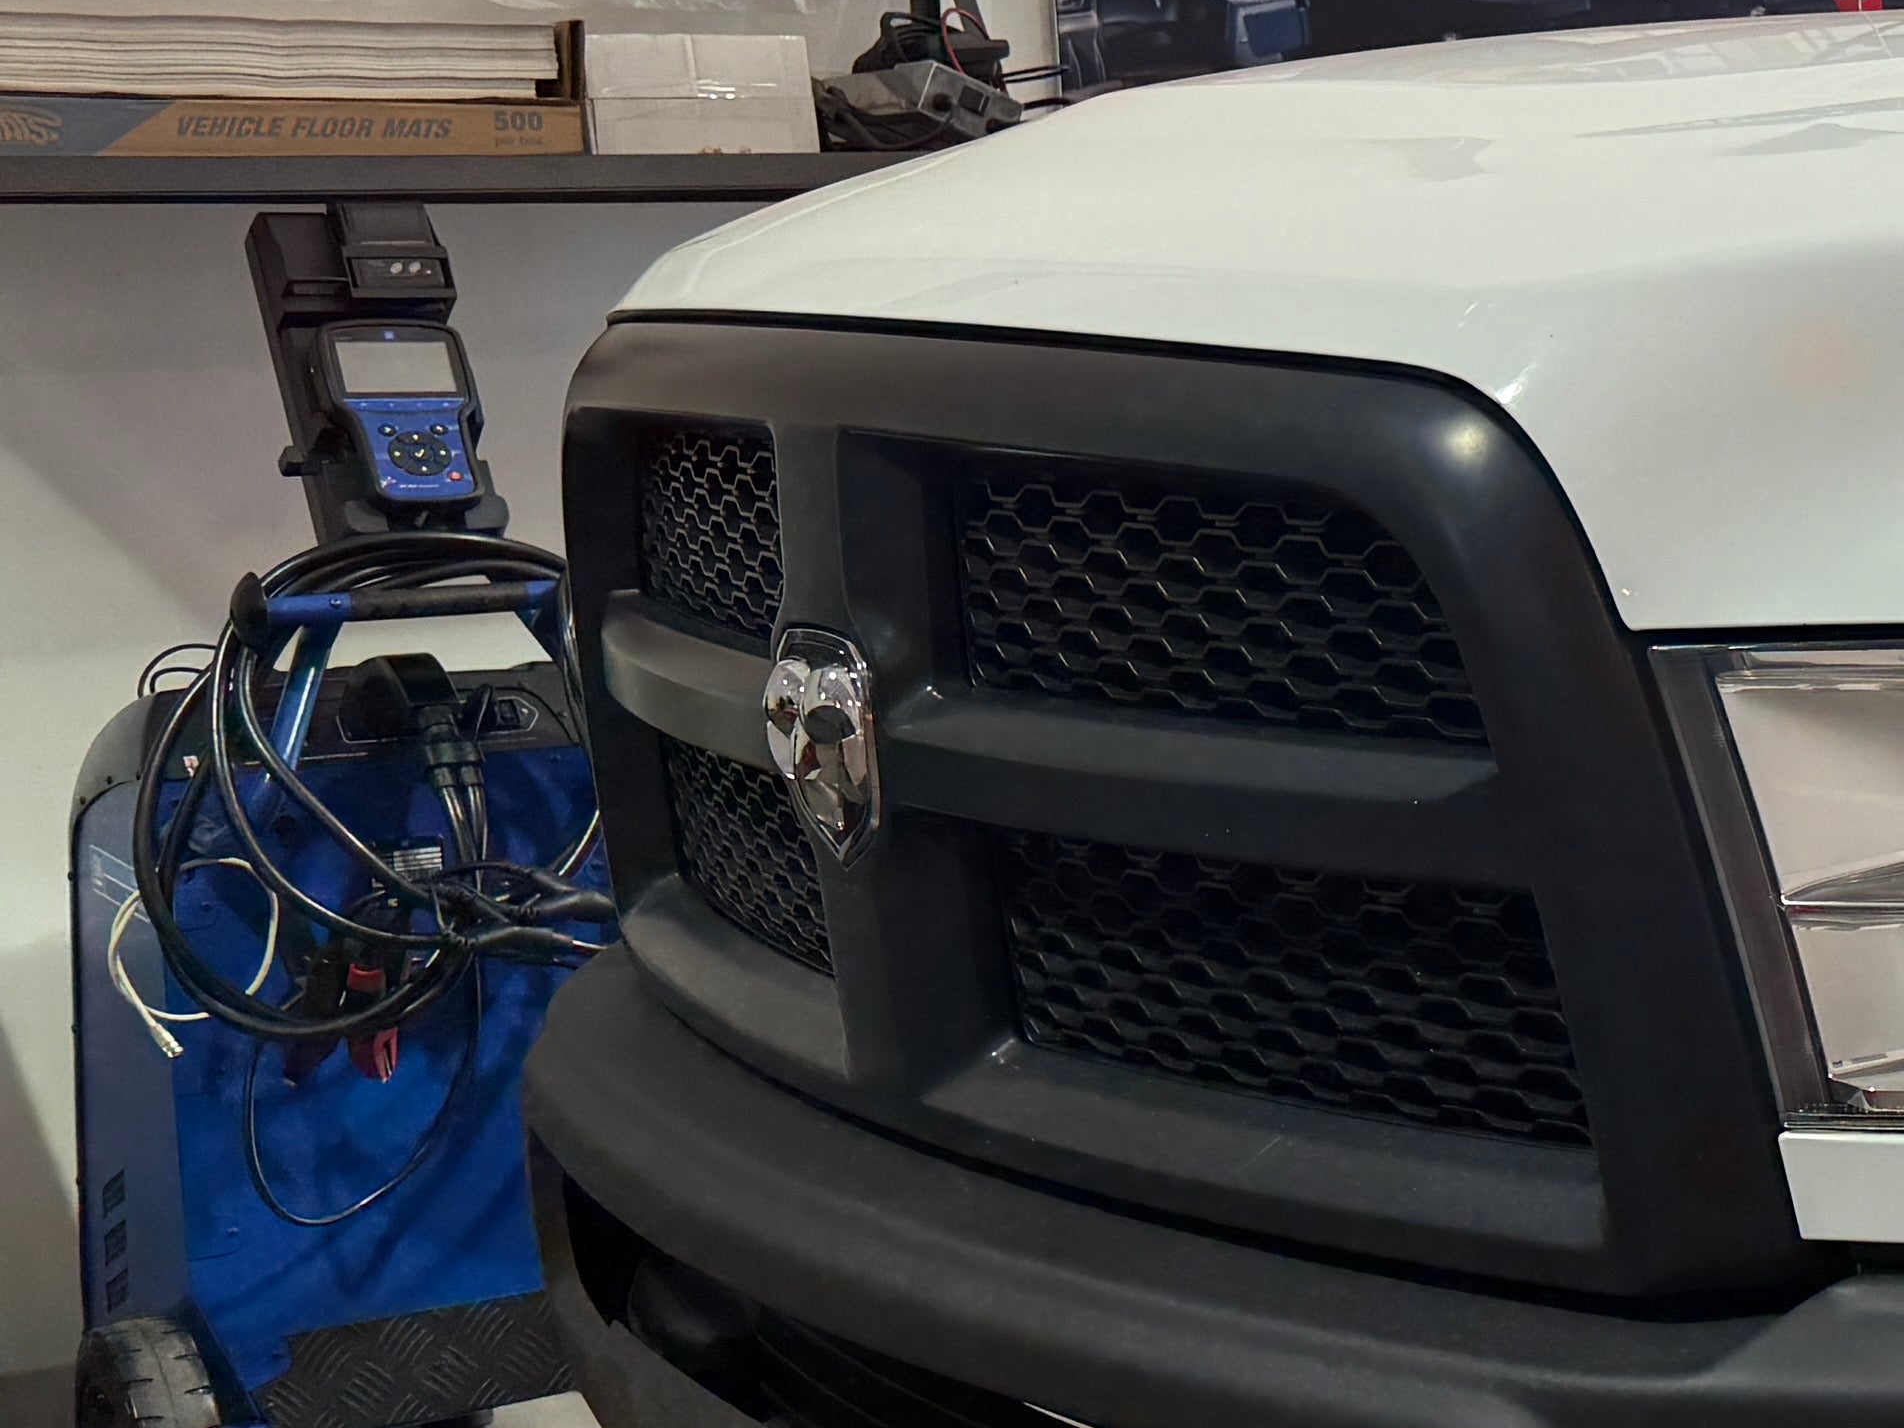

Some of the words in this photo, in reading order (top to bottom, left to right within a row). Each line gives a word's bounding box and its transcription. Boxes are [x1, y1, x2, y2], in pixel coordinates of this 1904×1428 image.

[176, 115, 284, 139] VEHICLE
[290, 116, 374, 140] FLOOR
[381, 116, 454, 140] MATS
[495, 110, 544, 132] 500
